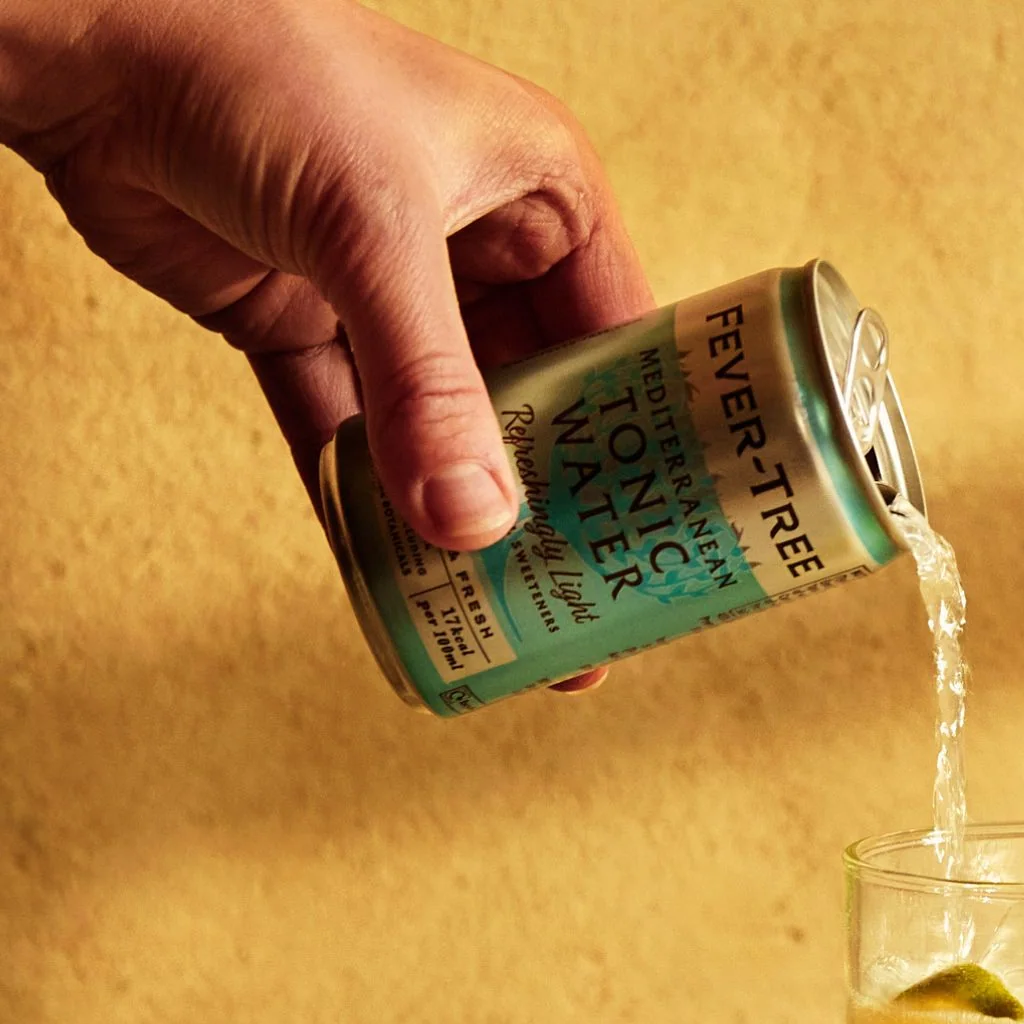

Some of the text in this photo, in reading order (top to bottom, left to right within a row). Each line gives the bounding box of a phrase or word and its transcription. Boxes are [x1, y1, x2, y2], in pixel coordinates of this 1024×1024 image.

[501, 403, 600, 625] Refreshingly Light
[551, 397, 643, 600] WATER
[599, 387, 690, 574] TONIC
[640, 348, 738, 589] MEDITERRANEAN
[706, 304, 824, 578] FEVER-TREE
[416, 600, 438, 627] per
[433, 630, 464, 671] 100ml
[441, 607, 475, 656] 17kcal
[456, 570, 494, 639] FRESH
[511, 540, 560, 634] SWEETENERS
